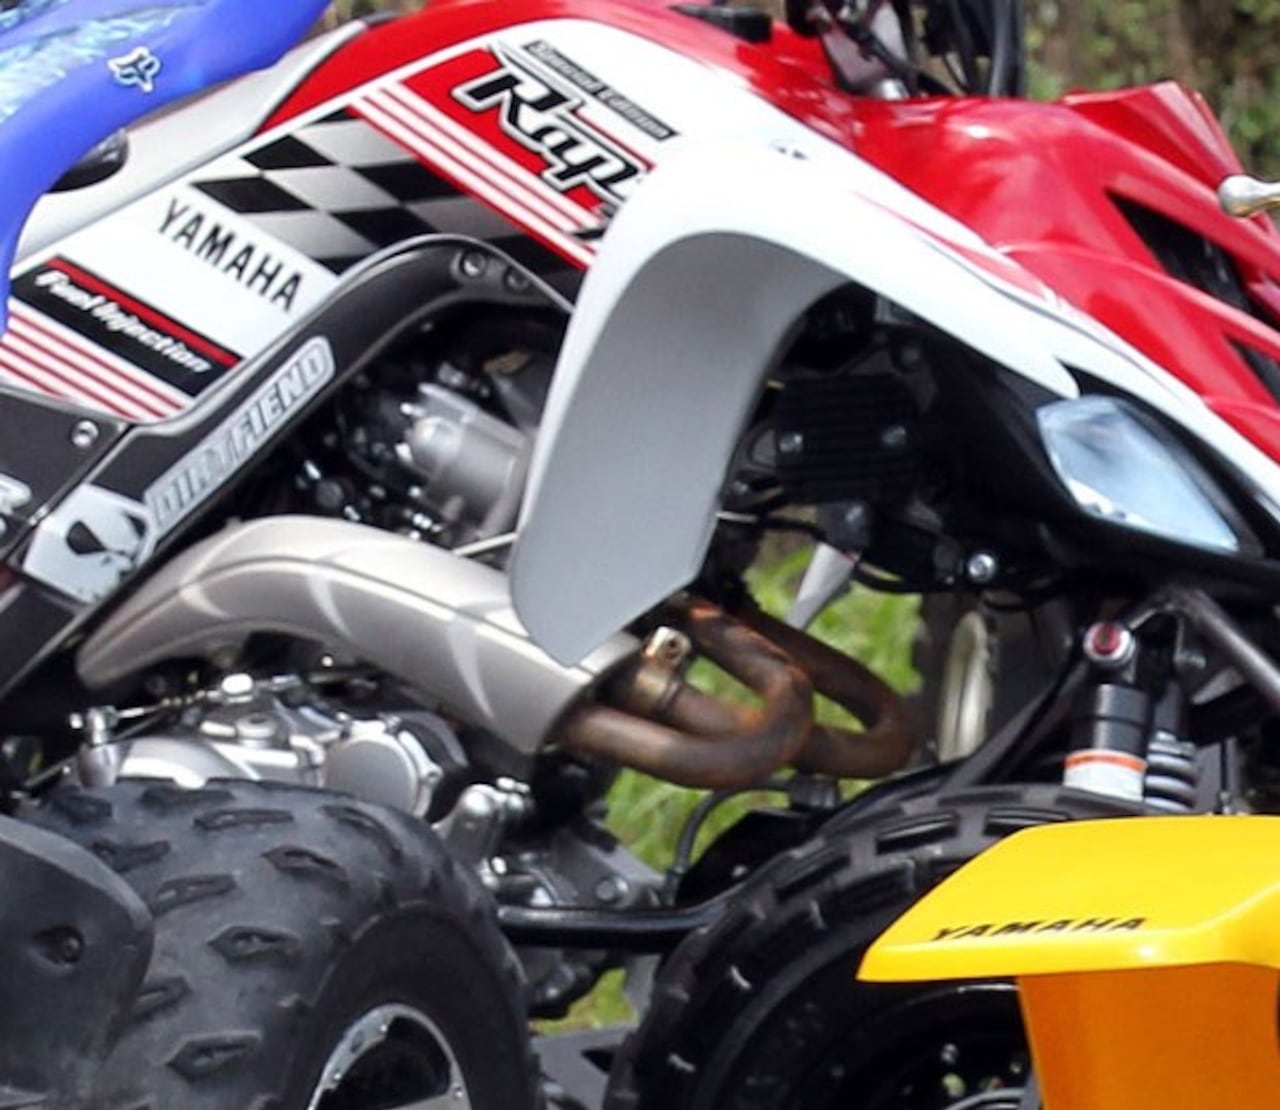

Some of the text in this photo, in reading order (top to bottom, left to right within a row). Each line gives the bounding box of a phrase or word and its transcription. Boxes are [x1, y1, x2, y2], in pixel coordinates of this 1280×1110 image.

[158, 198, 305, 312] YAMAHA
[36, 270, 213, 374] Fuel Injection
[931, 917, 1148, 941] YAMAHA
